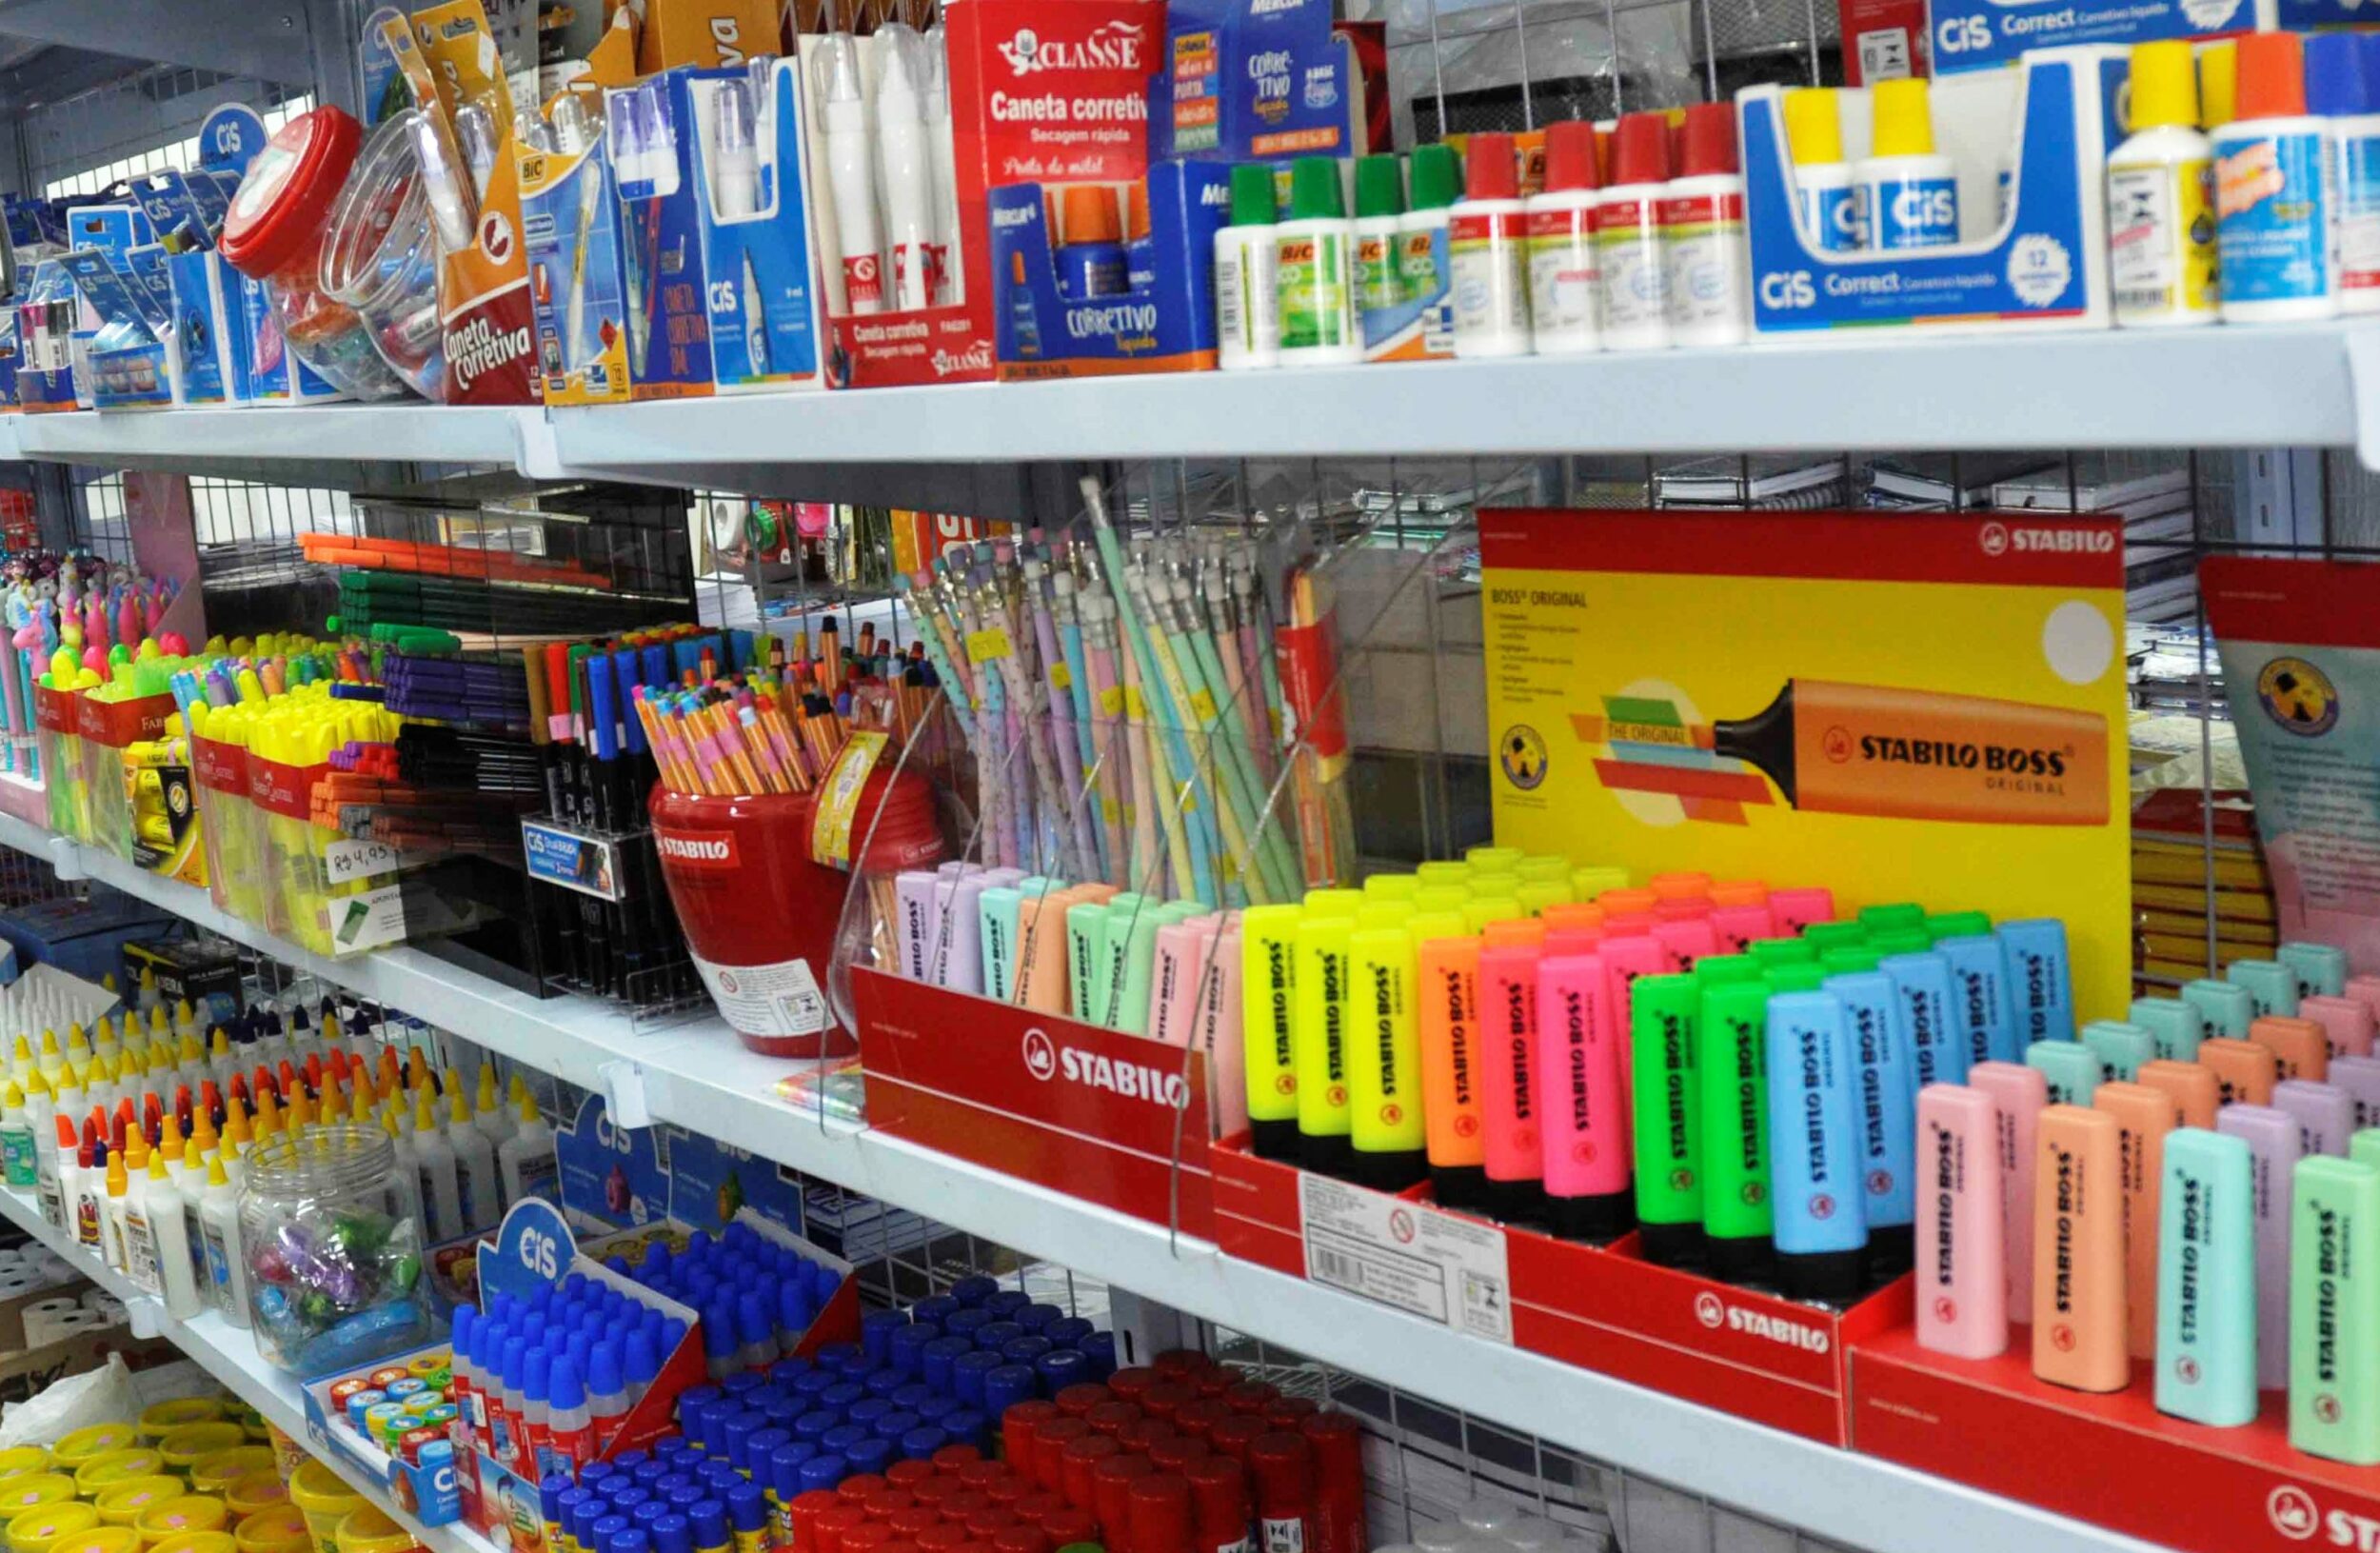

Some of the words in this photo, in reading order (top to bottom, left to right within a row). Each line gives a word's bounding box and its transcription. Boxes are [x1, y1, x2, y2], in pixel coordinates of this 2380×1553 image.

[1039, 29, 1140, 70] CLASSE
[1938, 13, 1993, 52] CiS
[2001, 8, 2075, 36] Correct
[990, 90, 1067, 122] Caneta
[1072, 92, 1148, 121] corretiv
[216, 122, 242, 152] CiS
[1891, 188, 1955, 228] CiS
[1360, 244, 1382, 262] IC
[709, 280, 738, 313] CiS
[1760, 271, 1816, 309] CiS
[1825, 271, 1900, 297] Correct
[442, 318, 490, 364] Caneta
[1066, 304, 1157, 338] CORRETIVO
[455, 327, 531, 390] corretiva
[2013, 528, 2114, 553] STABILO
[1860, 735, 1978, 769] STABILO
[1985, 746, 2066, 778] BOSS
[1986, 777, 2066, 797] ORIGINAL
[664, 835, 730, 860] STABILO
[1269, 942, 1284, 989] BOSS
[1323, 954, 1339, 1002] BOSS
[1376, 966, 1391, 1015] BOSS
[2026, 954, 2046, 1008] BOSS
[1447, 971, 1463, 1022] BOSS
[1508, 984, 1525, 1035] BOSS
[1567, 992, 1584, 1045] BOSS
[1911, 990, 1931, 1047] BOSS
[1964, 972, 1984, 1027] BOSS
[1273, 992, 1290, 1066] STABILO
[1326, 1005, 1342, 1081] STABILO
[1663, 1016, 1682, 1070] BOSS
[1735, 1023, 1755, 1079] BOSS
[1856, 1007, 1875, 1065] BOSS
[1060, 1047, 1191, 1109] STABILO
[1378, 1020, 1395, 1095] STABILO
[1451, 1026, 1469, 1105] STABILO
[1800, 1031, 1819, 1088] BOSS
[1571, 1049, 1589, 1130] STABILO
[1862, 1068, 1885, 1158] STABILO
[1805, 1092, 1828, 1183] STABILO
[1936, 1130, 1953, 1189] BOSS
[2056, 1151, 2072, 1212] BOSS
[2181, 1179, 2199, 1241] BOSS
[520, 1225, 557, 1280] CiS
[1937, 1193, 1954, 1286] STABILO
[2056, 1217, 2072, 1313] STABILO
[2318, 1210, 2335, 1275] BOSS
[1727, 1307, 1831, 1354] STABILO
[2318, 1279, 2335, 1382] STABILO
